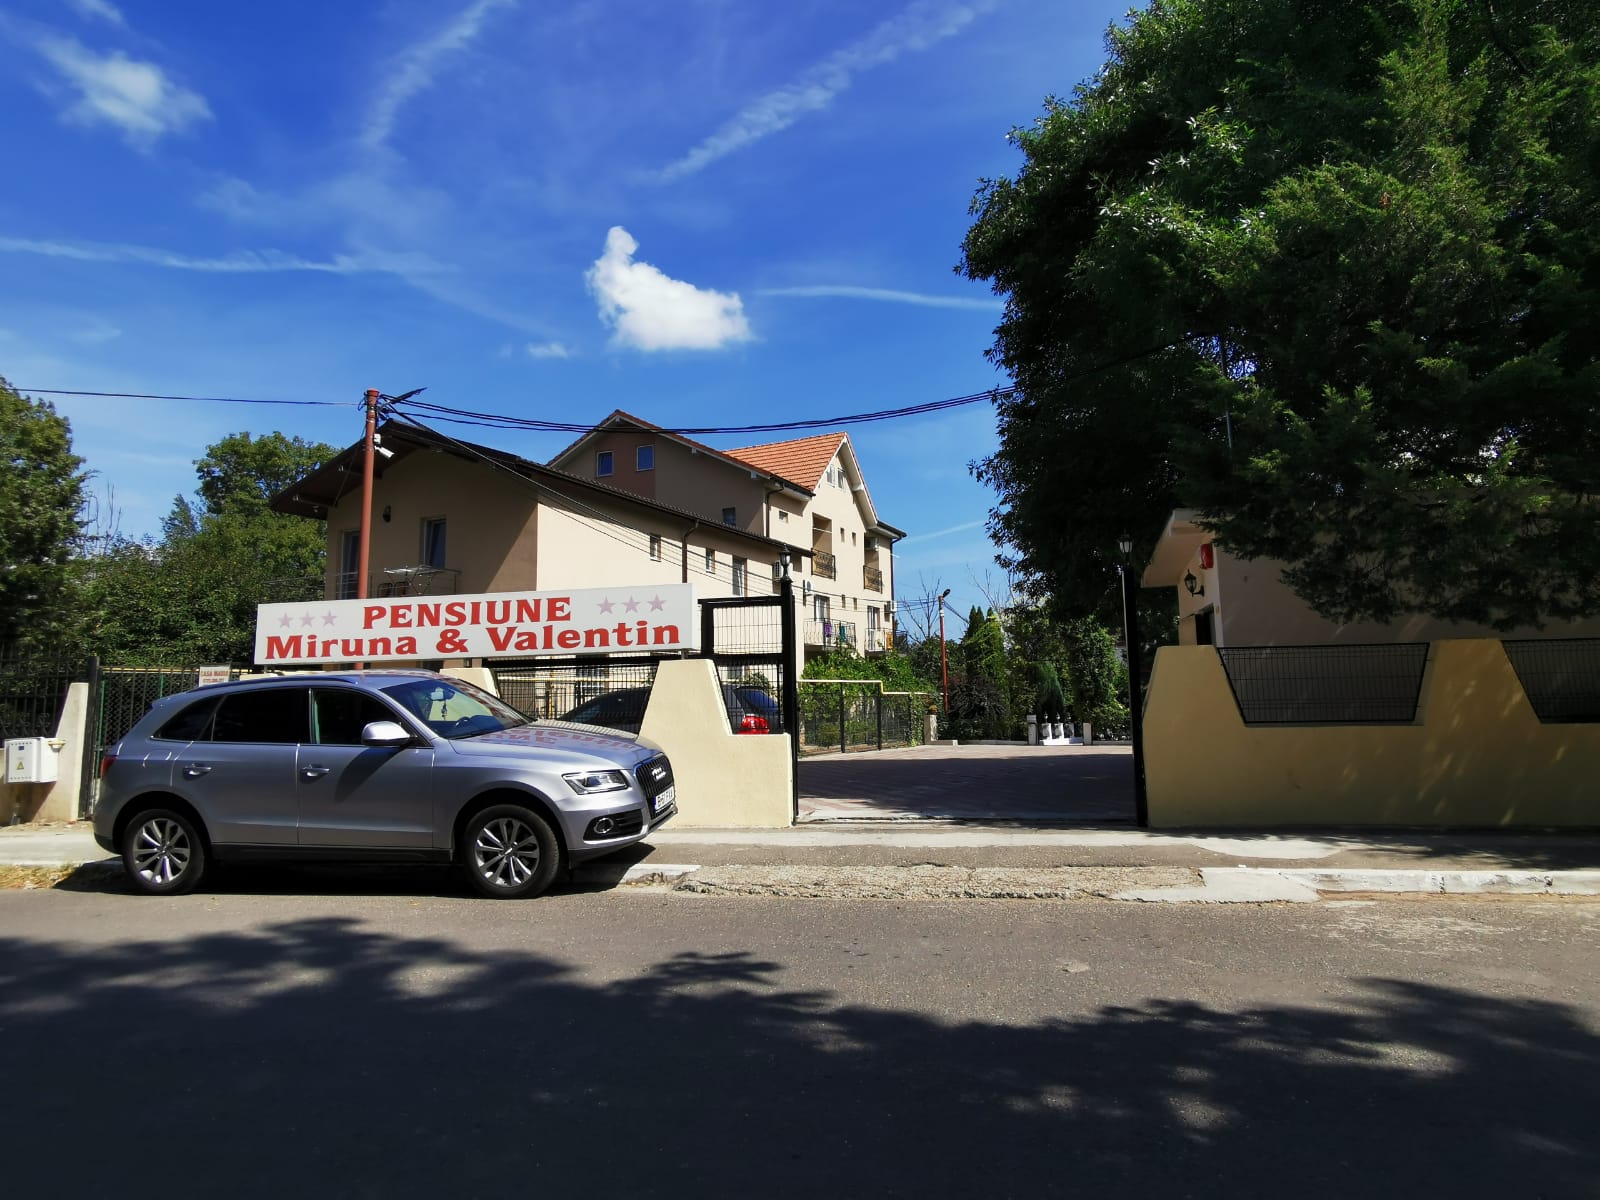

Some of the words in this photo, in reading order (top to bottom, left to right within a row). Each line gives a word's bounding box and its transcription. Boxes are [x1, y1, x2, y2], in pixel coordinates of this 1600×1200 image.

[363, 597, 571, 630] PENSIUNE
[264, 634, 418, 660] Miruna
[436, 628, 469, 654] &
[486, 620, 680, 652] Valentin
